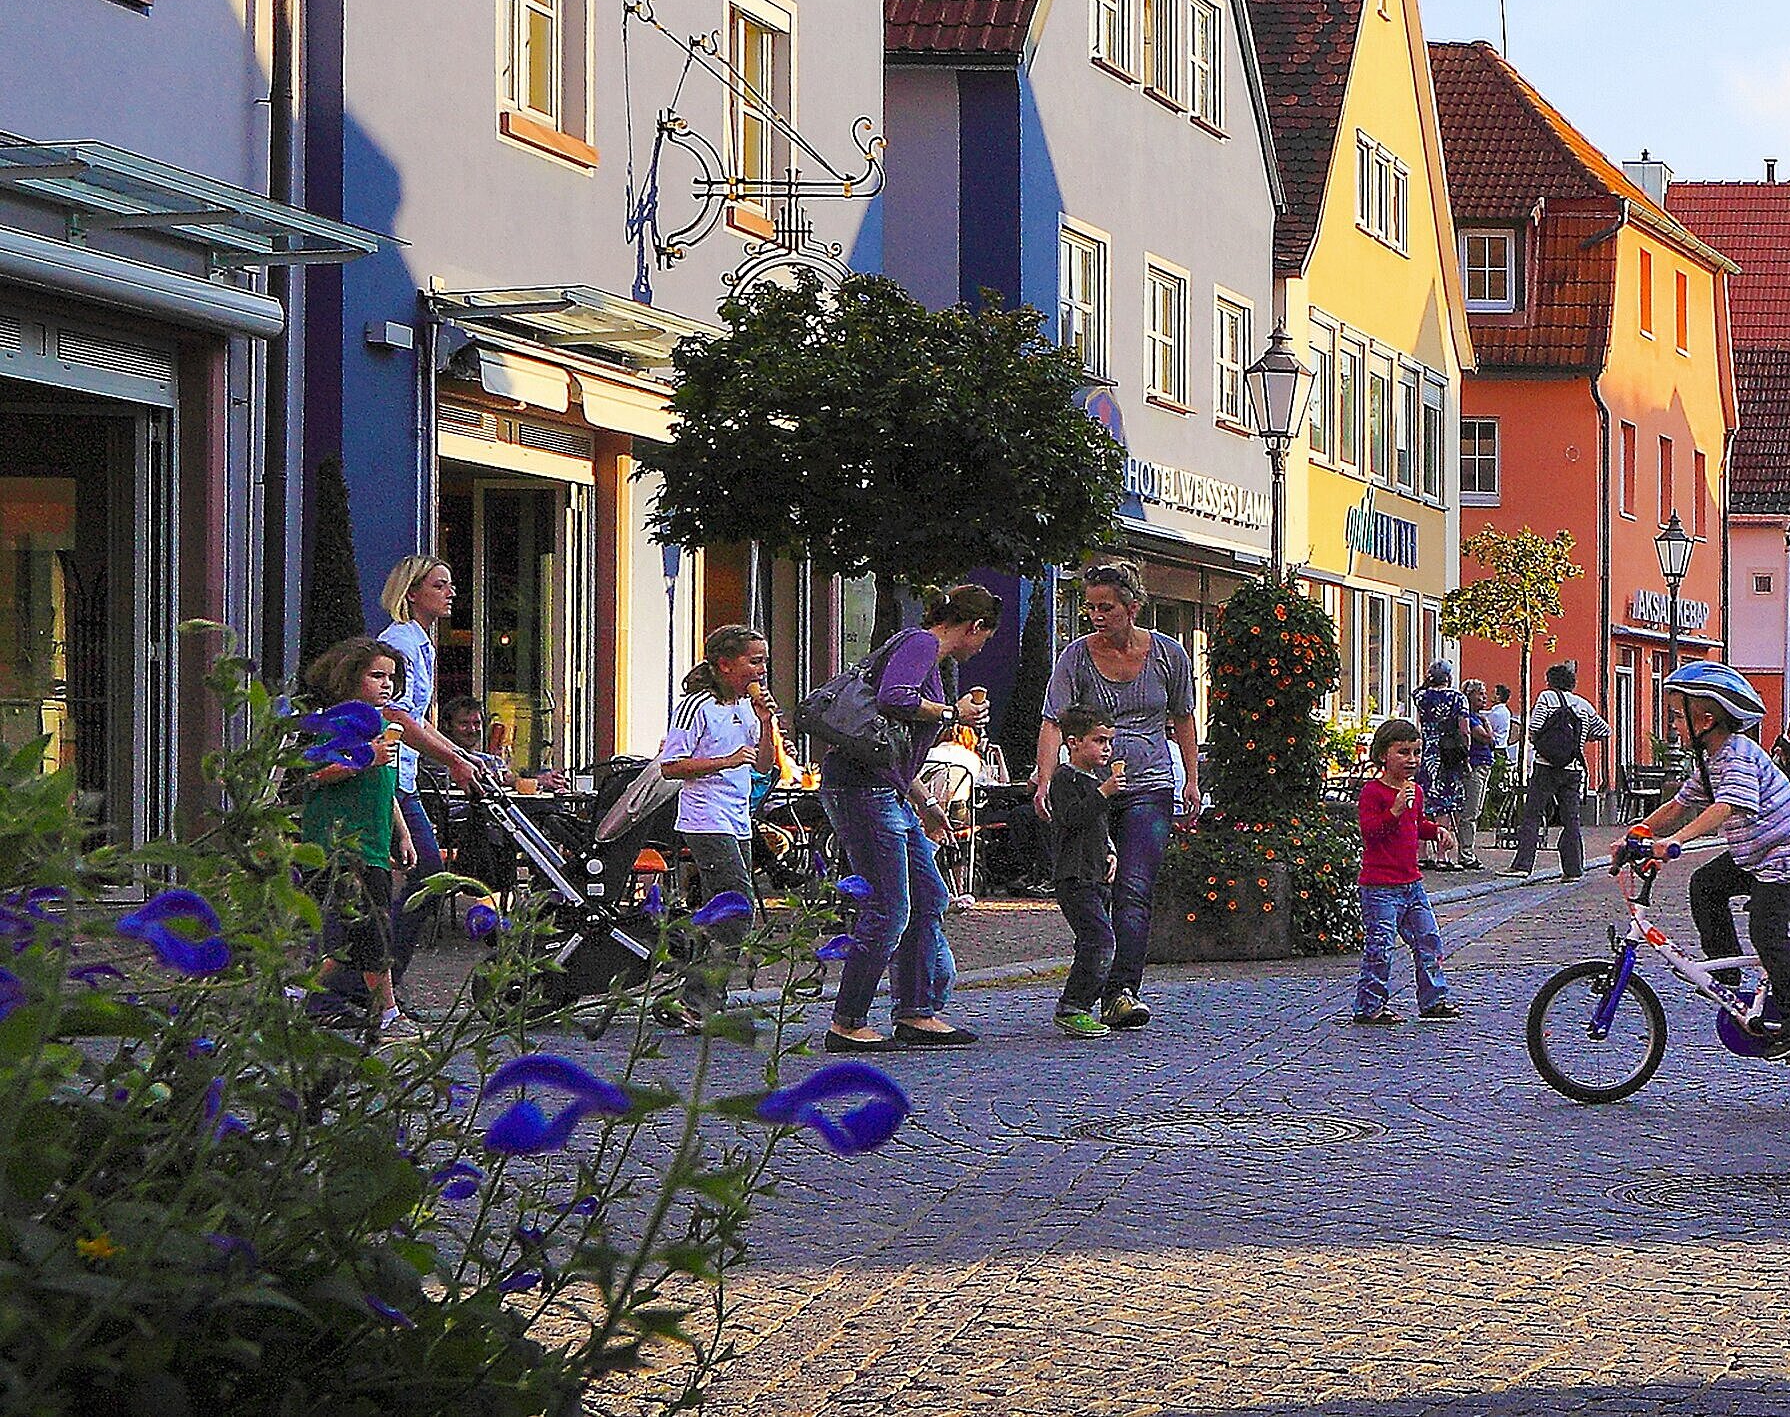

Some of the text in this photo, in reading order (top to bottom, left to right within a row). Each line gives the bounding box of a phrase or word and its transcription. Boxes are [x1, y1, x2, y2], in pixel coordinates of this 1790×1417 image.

[1126, 456, 1179, 504] HOTEL
[1179, 469, 1238, 521] WEISSES
[1374, 510, 1418, 570] HUTH
[1677, 596, 1709, 630] KEBAP
